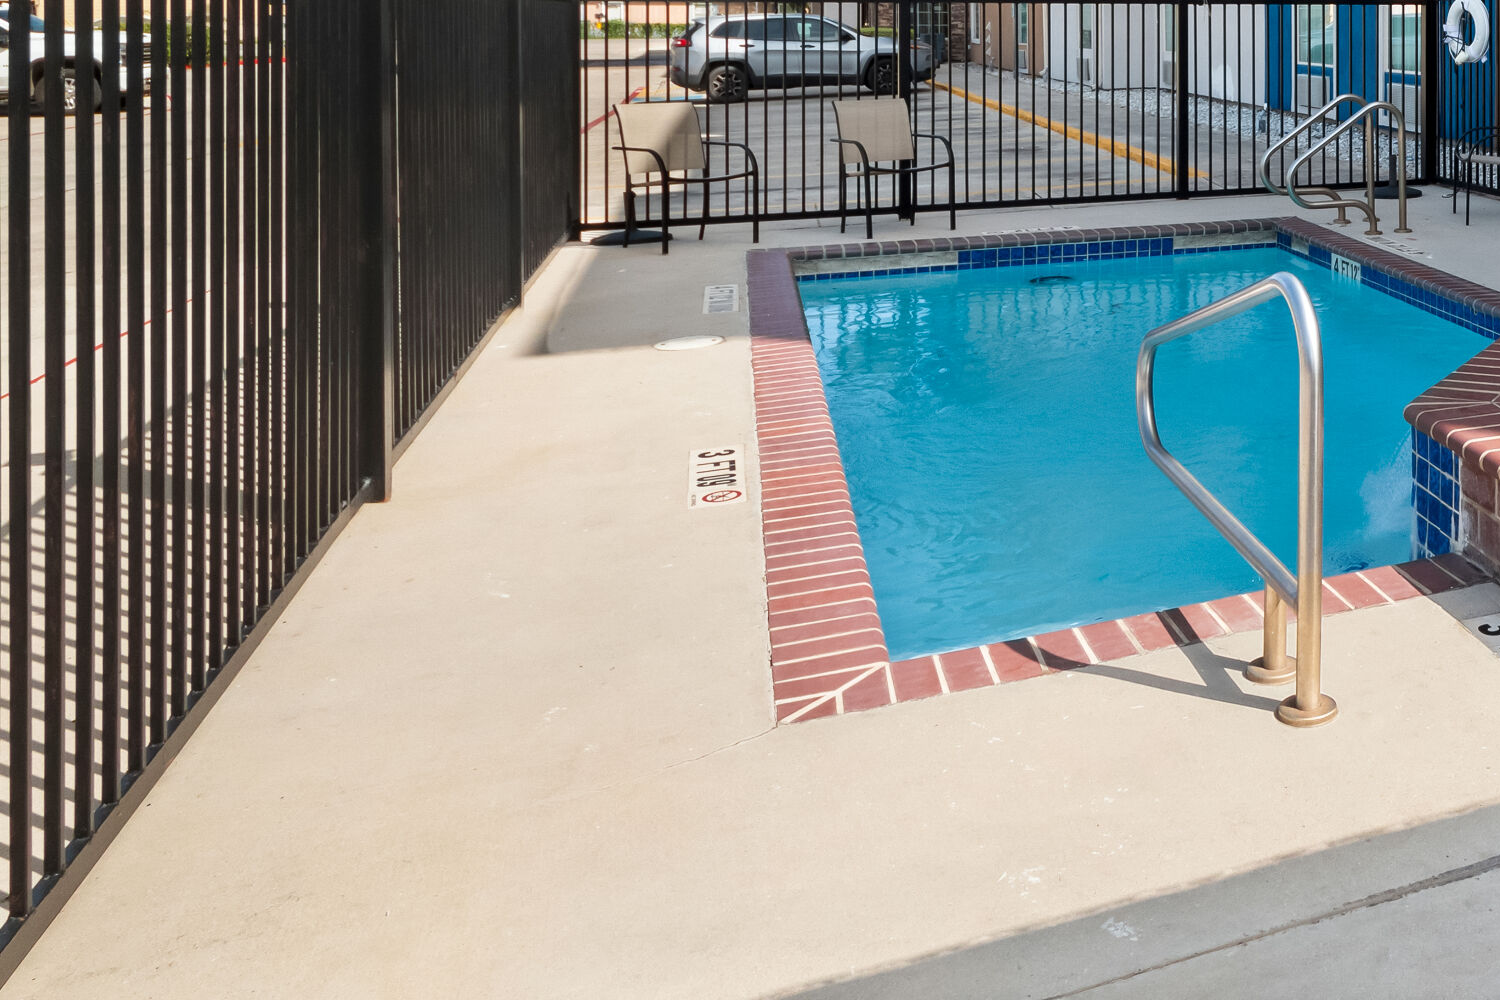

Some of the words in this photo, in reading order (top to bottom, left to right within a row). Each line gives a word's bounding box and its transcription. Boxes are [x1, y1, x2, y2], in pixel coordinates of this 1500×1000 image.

[1334, 257, 1339, 273] 4
[1341, 260, 1350, 278] FT
[697, 449, 736, 459] 3
[696, 459, 736, 474] FT
